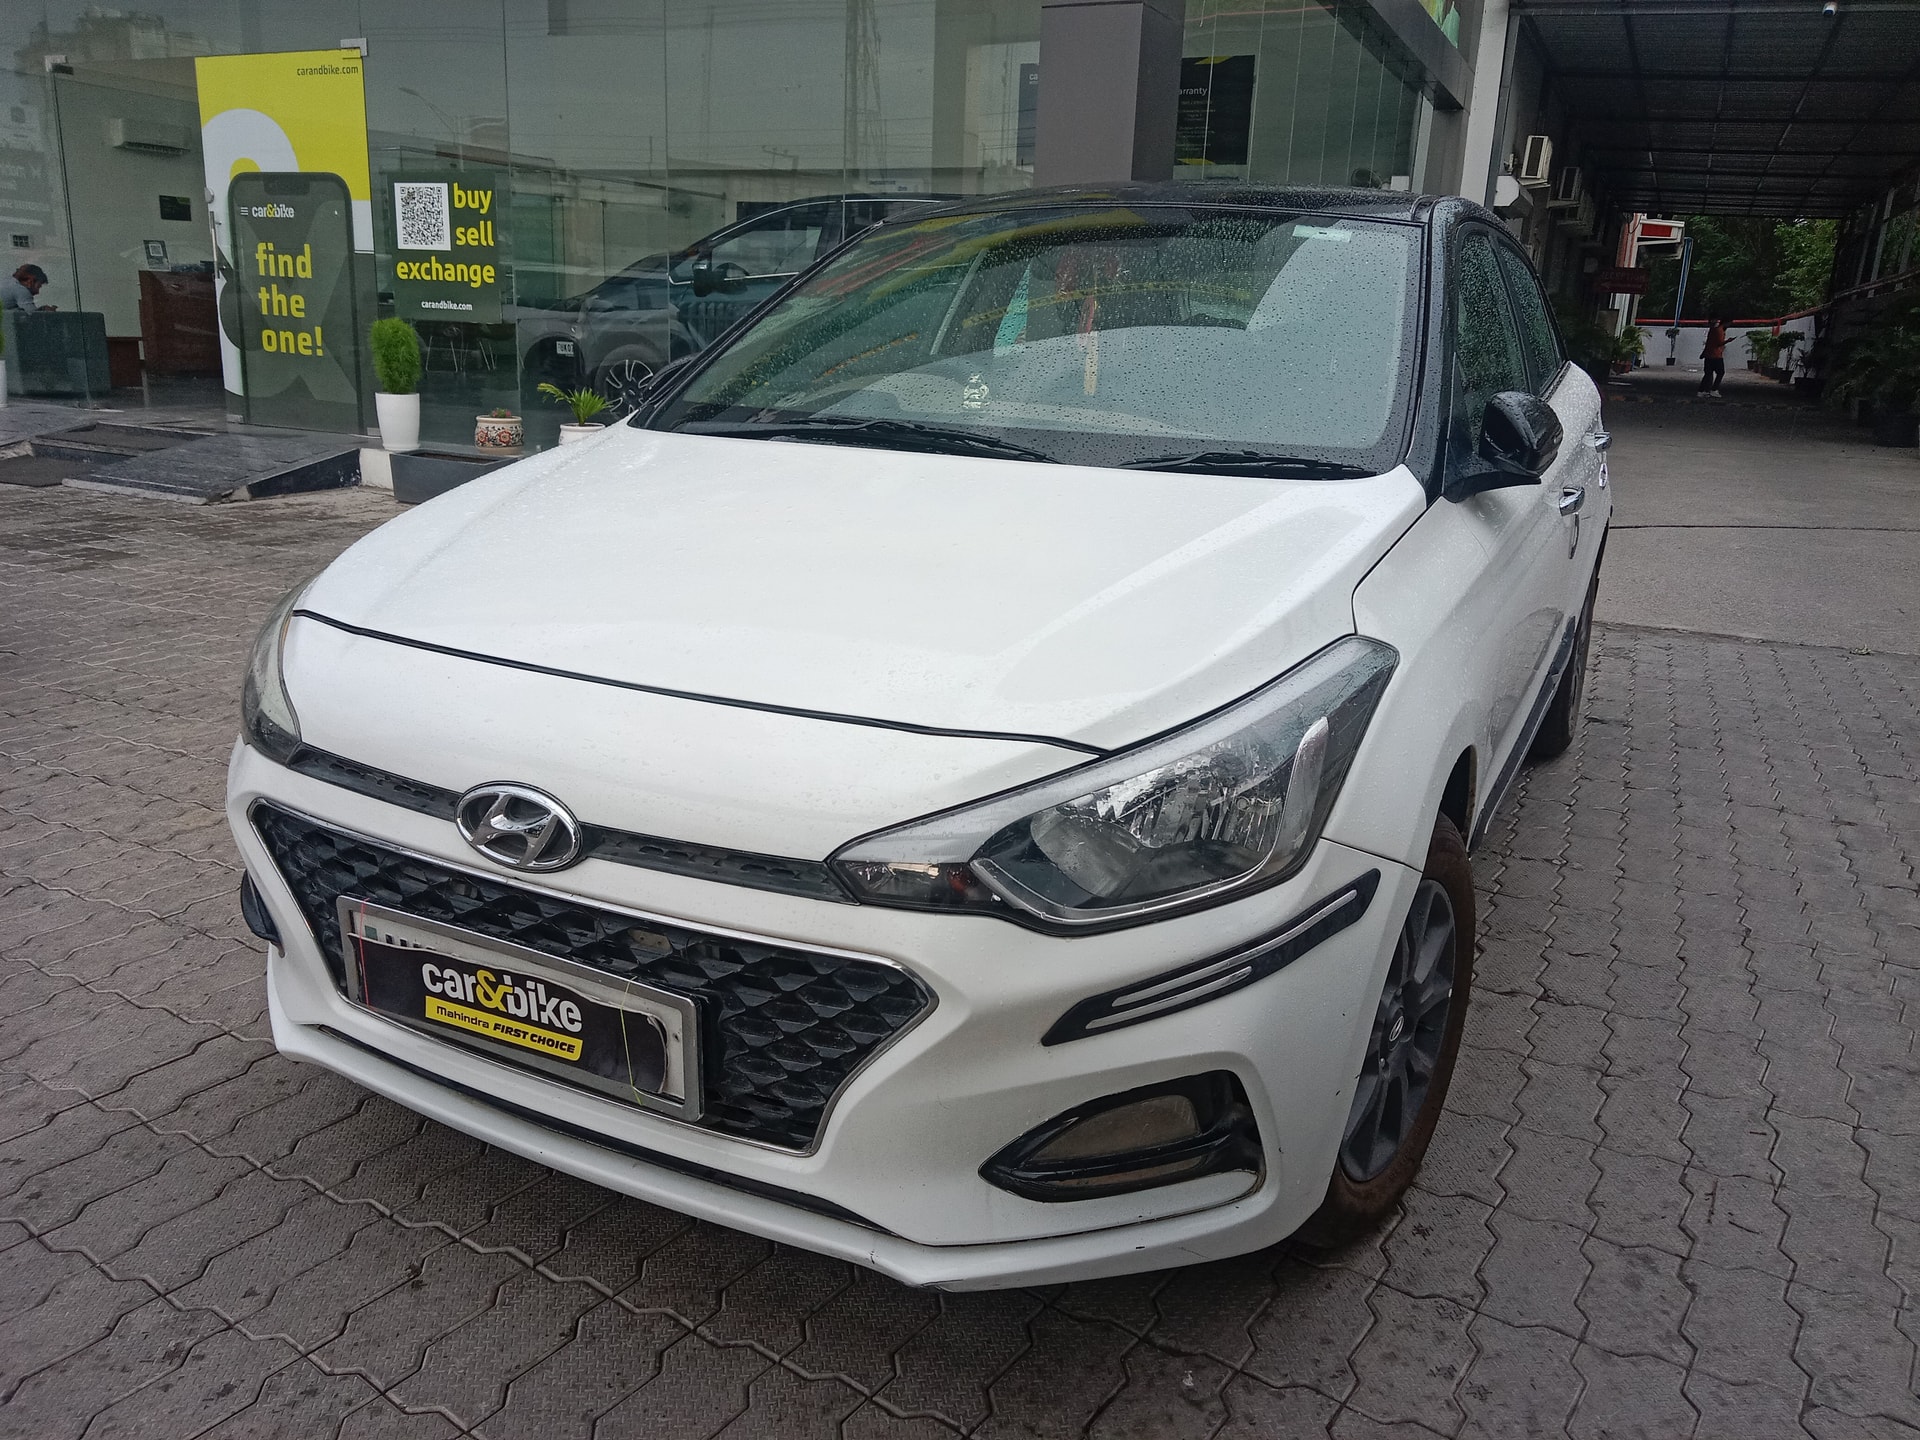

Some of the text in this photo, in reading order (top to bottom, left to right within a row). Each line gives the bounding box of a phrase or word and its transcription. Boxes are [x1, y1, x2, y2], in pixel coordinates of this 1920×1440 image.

[296, 64, 359, 77] carandbike.com
[252, 203, 295, 218] car&bike
[453, 182, 493, 215] buy
[455, 220, 495, 247] sell
[255, 242, 313, 279] find
[396, 256, 496, 288] exchange
[258, 284, 306, 318] the
[421, 300, 473, 312] carandbike.com
[262, 326, 324, 357] one!
[421, 963, 583, 1033] car&bike
[436, 1005, 576, 1053] Mahindra FIRST CHOICE
